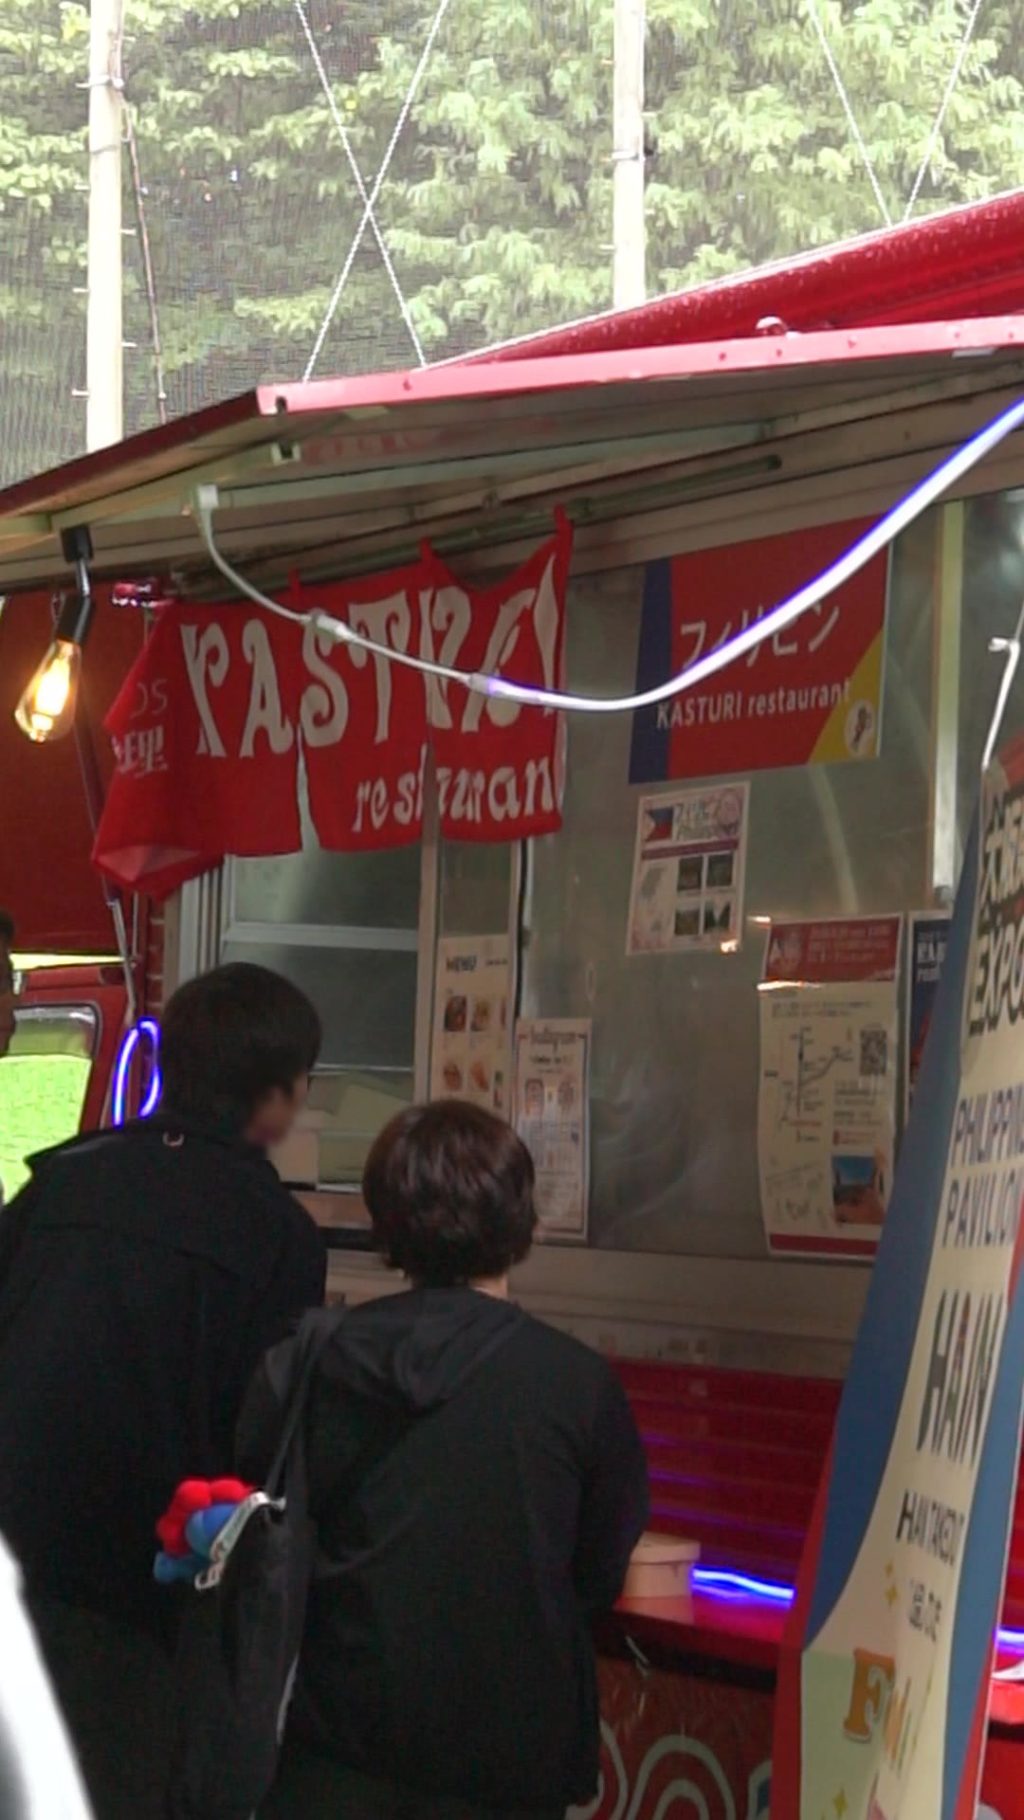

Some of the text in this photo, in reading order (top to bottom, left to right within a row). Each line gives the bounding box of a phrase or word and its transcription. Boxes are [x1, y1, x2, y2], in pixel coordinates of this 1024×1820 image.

[656, 676, 851, 730] KASTURI restaurant
[916, 1289, 1004, 1469] HAIN
